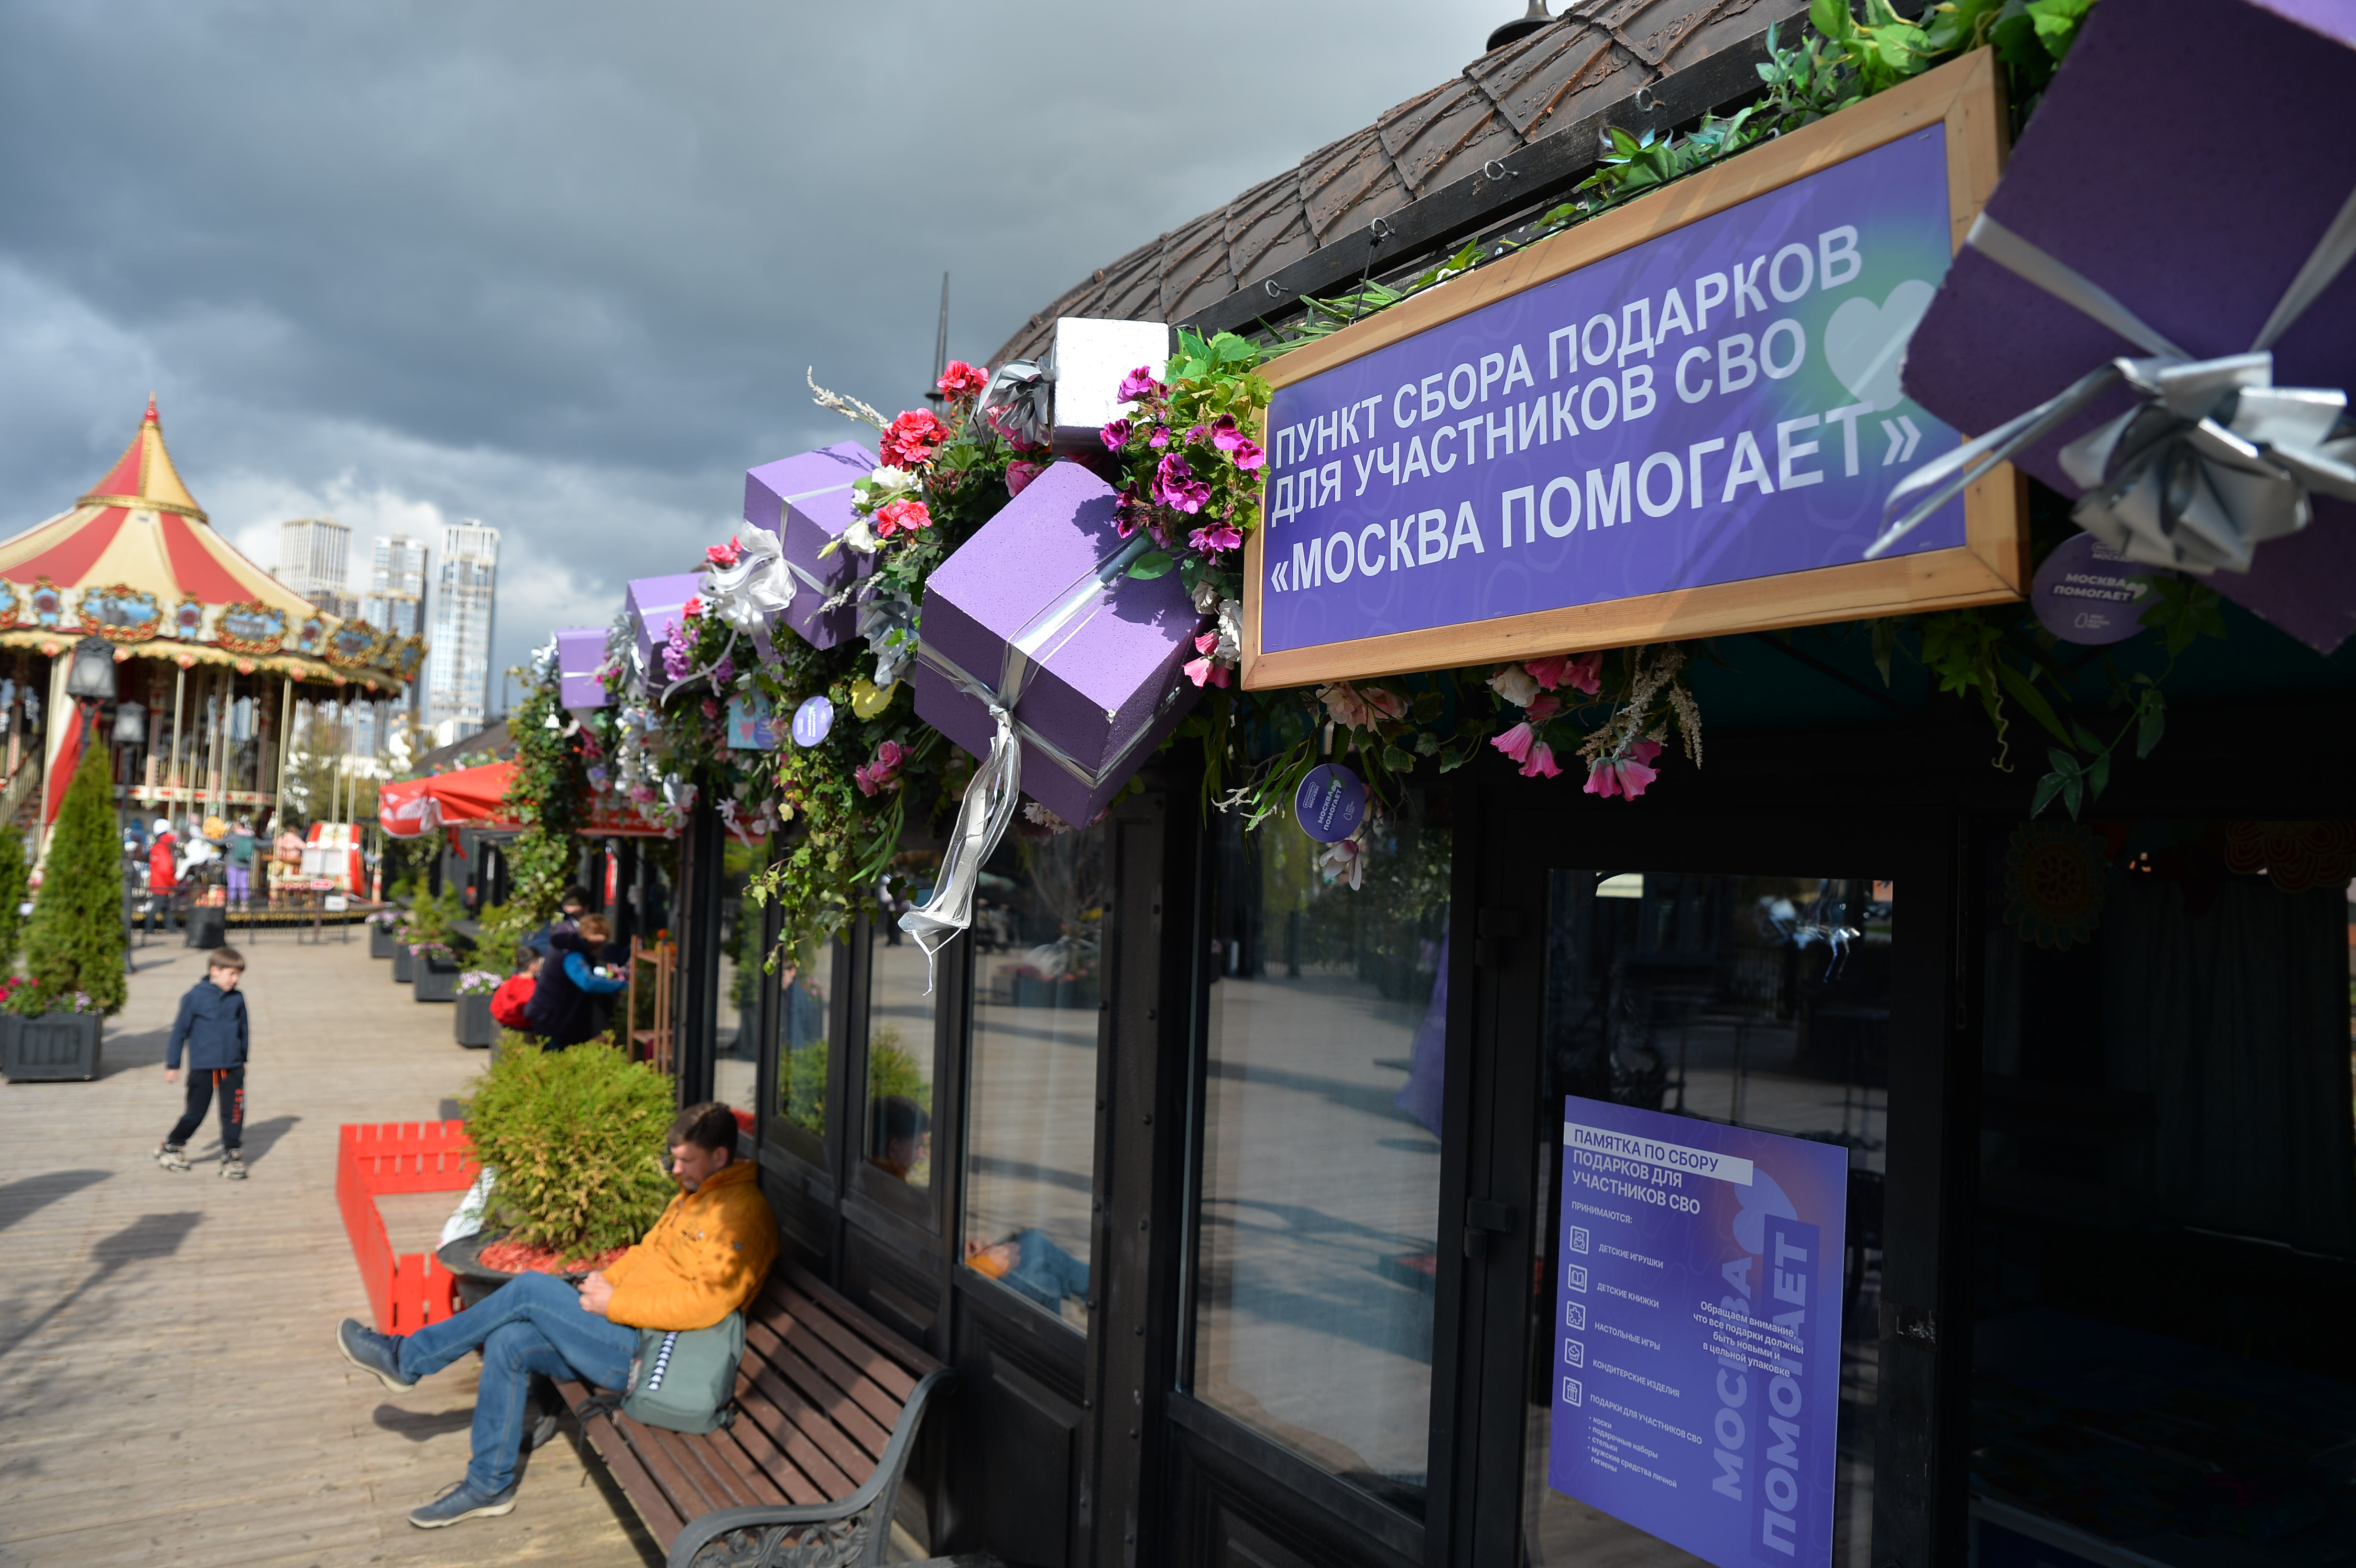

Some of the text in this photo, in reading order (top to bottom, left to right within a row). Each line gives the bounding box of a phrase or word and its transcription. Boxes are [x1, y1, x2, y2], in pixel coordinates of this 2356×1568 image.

[1276, 225, 1862, 468] ПУНКТ СБОРА ПОДАРКОВ
[1272, 318, 1806, 527] ДЛЯ УЧАСТНИКОВ СВО
[1271, 401, 1921, 593] «МОСКВА ПОМОГАЕТ»
[2053, 586, 2131, 601] ПОМОГАЕТ
[2065, 573, 2127, 588] МОСКВА
[1318, 791, 1333, 824] МОСКВА
[1323, 789, 1342, 830] ПОМОГАЕТ
[1573, 1149, 1682, 1187] ПОДАРКОВ ДЛЯ
[1575, 1129, 1718, 1172] ПАМЯТКА ПО СБОРУ
[1572, 1170, 1700, 1214] УЧАСТНИКОВ СВО
[1572, 1201, 1633, 1223] ПРИНИМАЮТСЯ:
[1599, 1244, 1663, 1269] ДЕТСКИЕ ИГРУШКИ
[1597, 1283, 1659, 1308] ДЕТСКИЕ КНИЖКИ
[1594, 1322, 1660, 1350] НАСТОЛЬНЫЕ ИГРЫ
[1693, 1313, 1804, 1354] что все подарки должны
[1701, 1301, 1796, 1339] Обращаем внимание,
[1710, 1344, 1746, 1363] цельной
[1748, 1357, 1790, 1377] упаковке
[1713, 1331, 1735, 1346] быть
[1737, 1340, 1772, 1358] новыми
[1593, 1359, 1680, 1397] КОНДИТЕРСКИЕ ИЗДЕЛИЯ
[1712, 1256, 1752, 1502] МОСКВА
[1763, 1231, 1807, 1557] ПОМОГАЕТ
[1590, 1394, 1702, 1444] ПОДАРКИ ДЛЯ УЧАСТНИКОВ СВО
[1593, 1417, 1612, 1429] носки
[1592, 1427, 1658, 1459] подарочные наборы
[1592, 1437, 1617, 1452] стельки
[1591, 1457, 1617, 1472] гигиены
[1592, 1447, 1677, 1488] мужские средства личной
